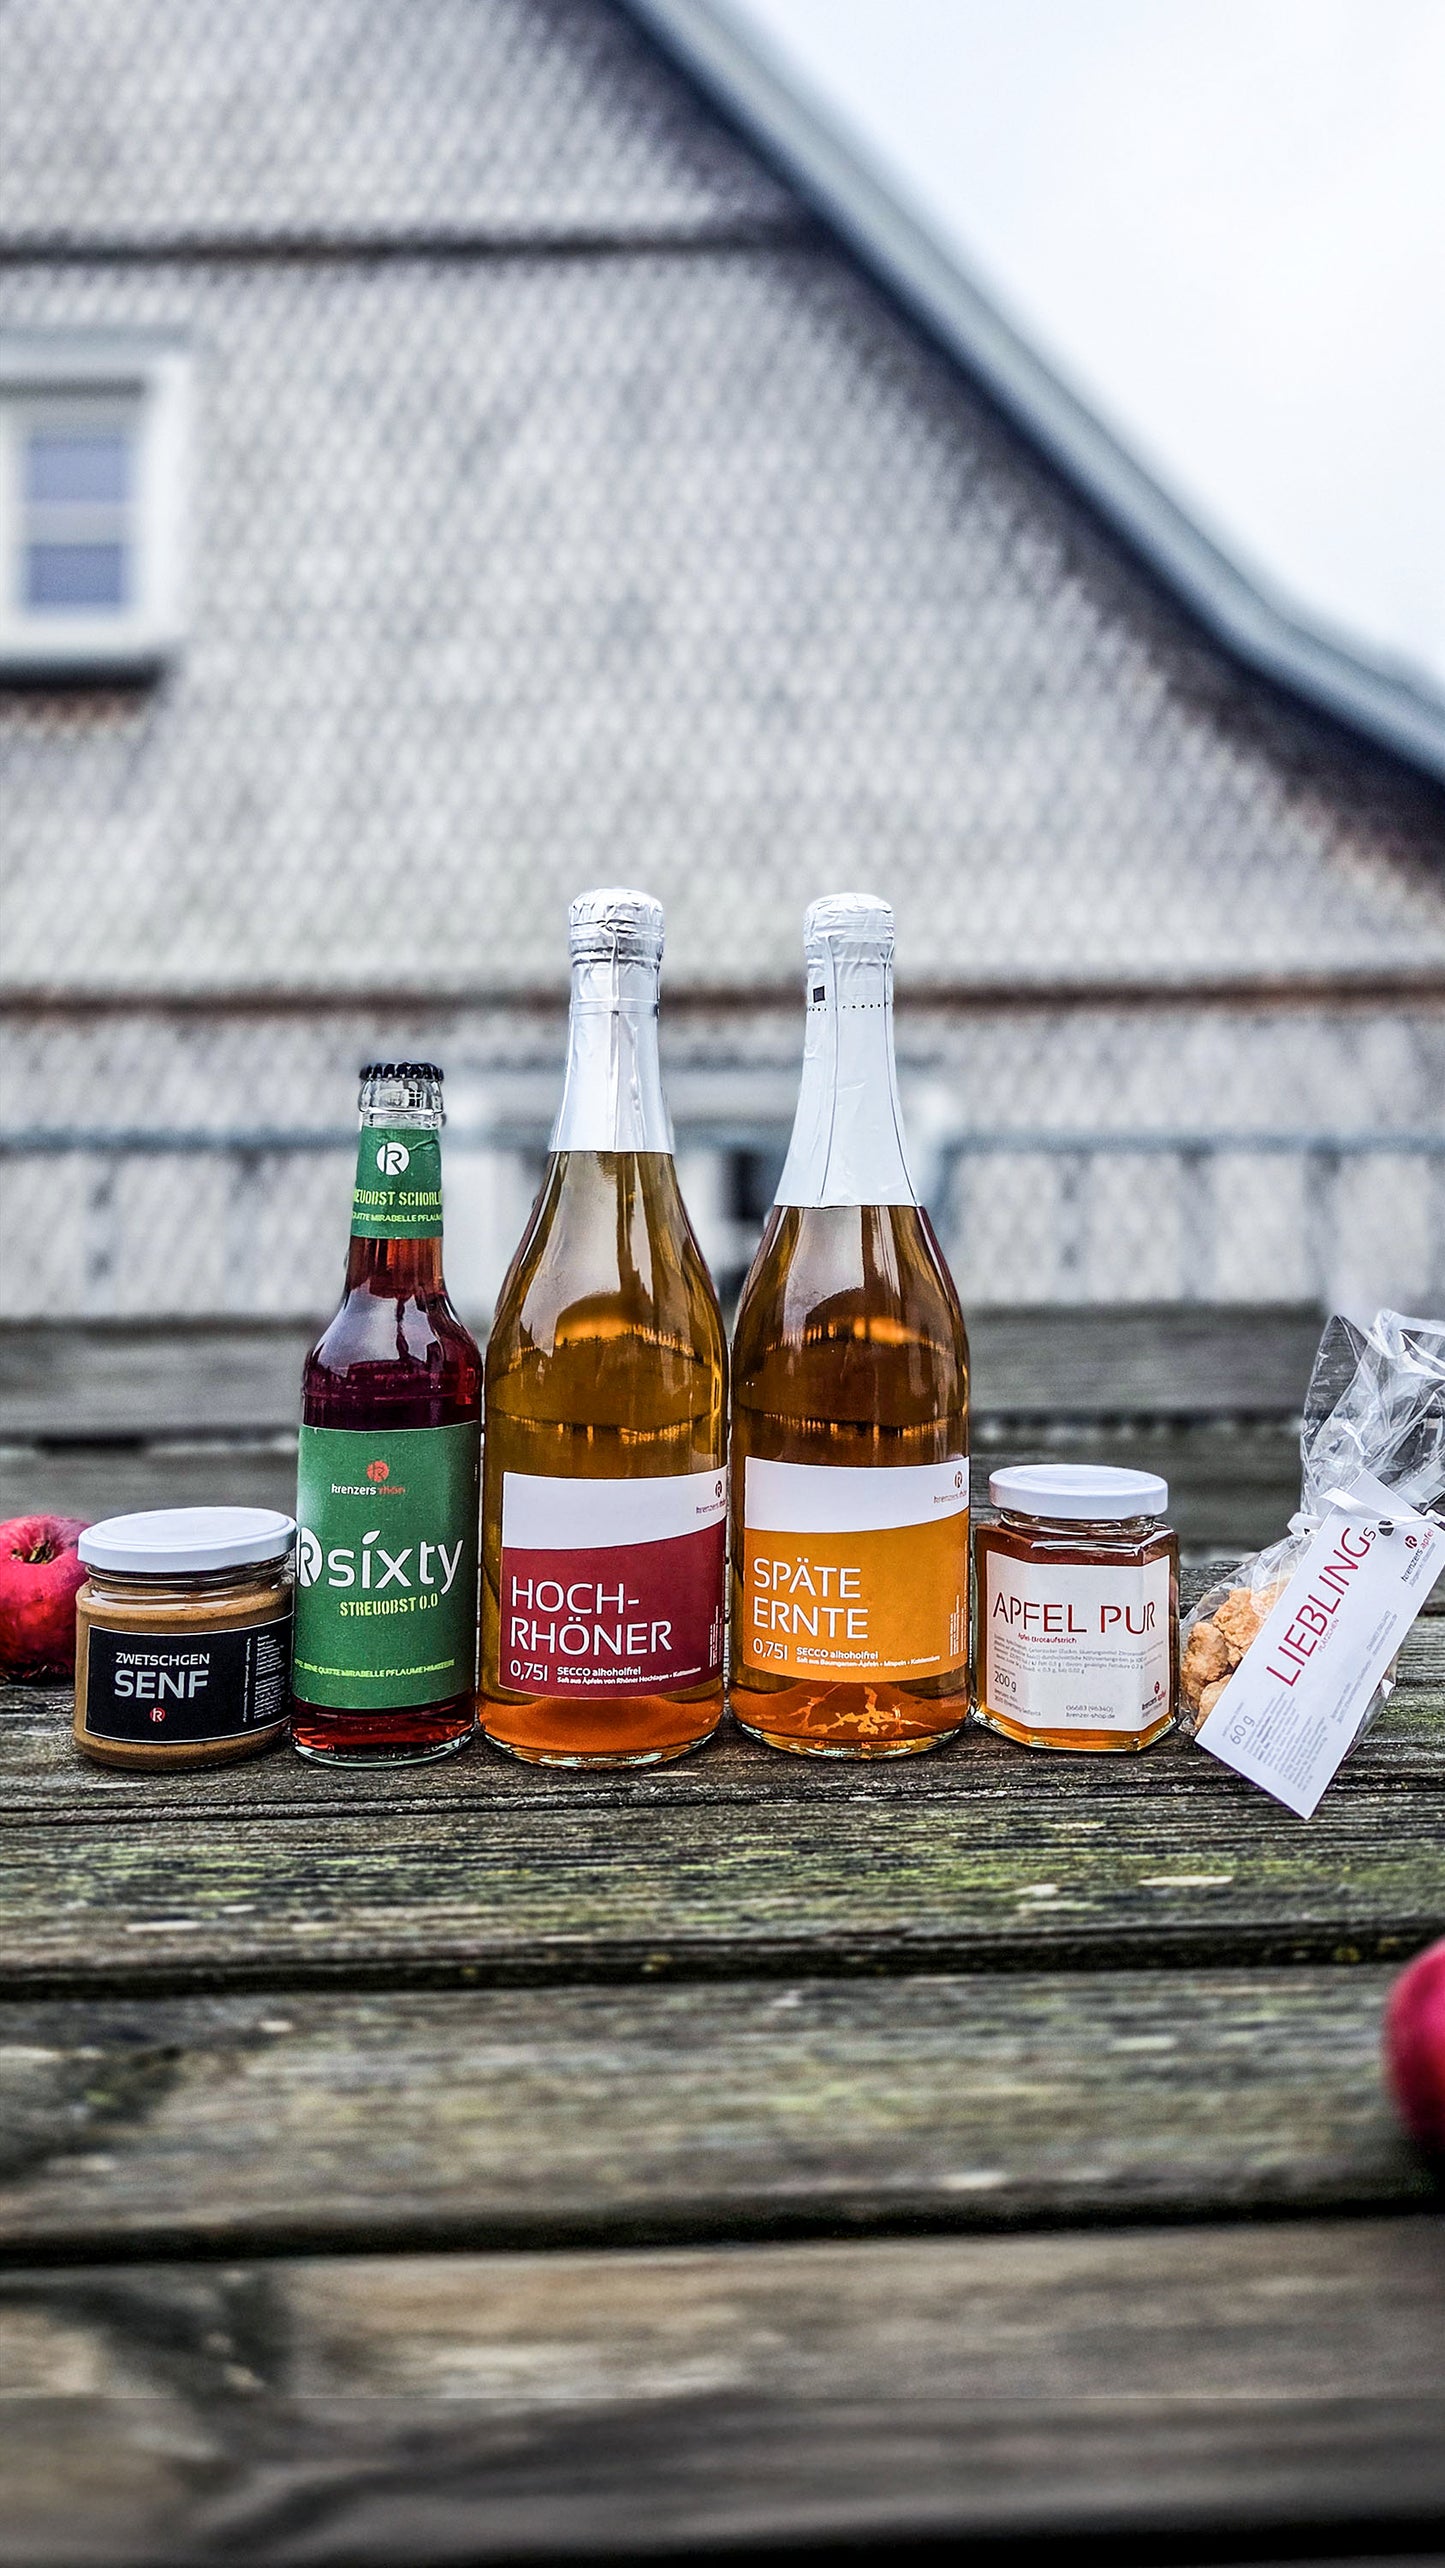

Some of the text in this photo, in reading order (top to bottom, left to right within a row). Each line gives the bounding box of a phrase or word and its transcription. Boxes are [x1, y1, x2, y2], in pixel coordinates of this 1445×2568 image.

[331, 1484, 377, 1496] krenzers
[1420, 1527, 1435, 1551] apfel
[753, 1557, 862, 1600] SPÄTE
[339, 1593, 438, 1617] STREUOBST 0.0
[511, 1576, 640, 1614] HOCH-
[753, 1596, 869, 1639] ERNTE
[992, 1592, 1088, 1634] APFEL
[1100, 1601, 1156, 1635] PUR
[510, 1616, 673, 1656] RHÖNER
[115, 1652, 210, 1666] ZWETSCHGEN
[753, 1637, 788, 1661] 0,75l
[796, 1646, 829, 1658] SECCO
[385, 1667, 424, 1678] PFLAUME
[510, 1660, 548, 1682] 0,75l
[557, 1666, 591, 1677] SECCO
[994, 1670, 1010, 1688] 200
[1011, 1681, 1017, 1693] g
[114, 1670, 210, 1699] SENF
[1229, 1725, 1246, 1745] 60
[1246, 1715, 1255, 1728] g
